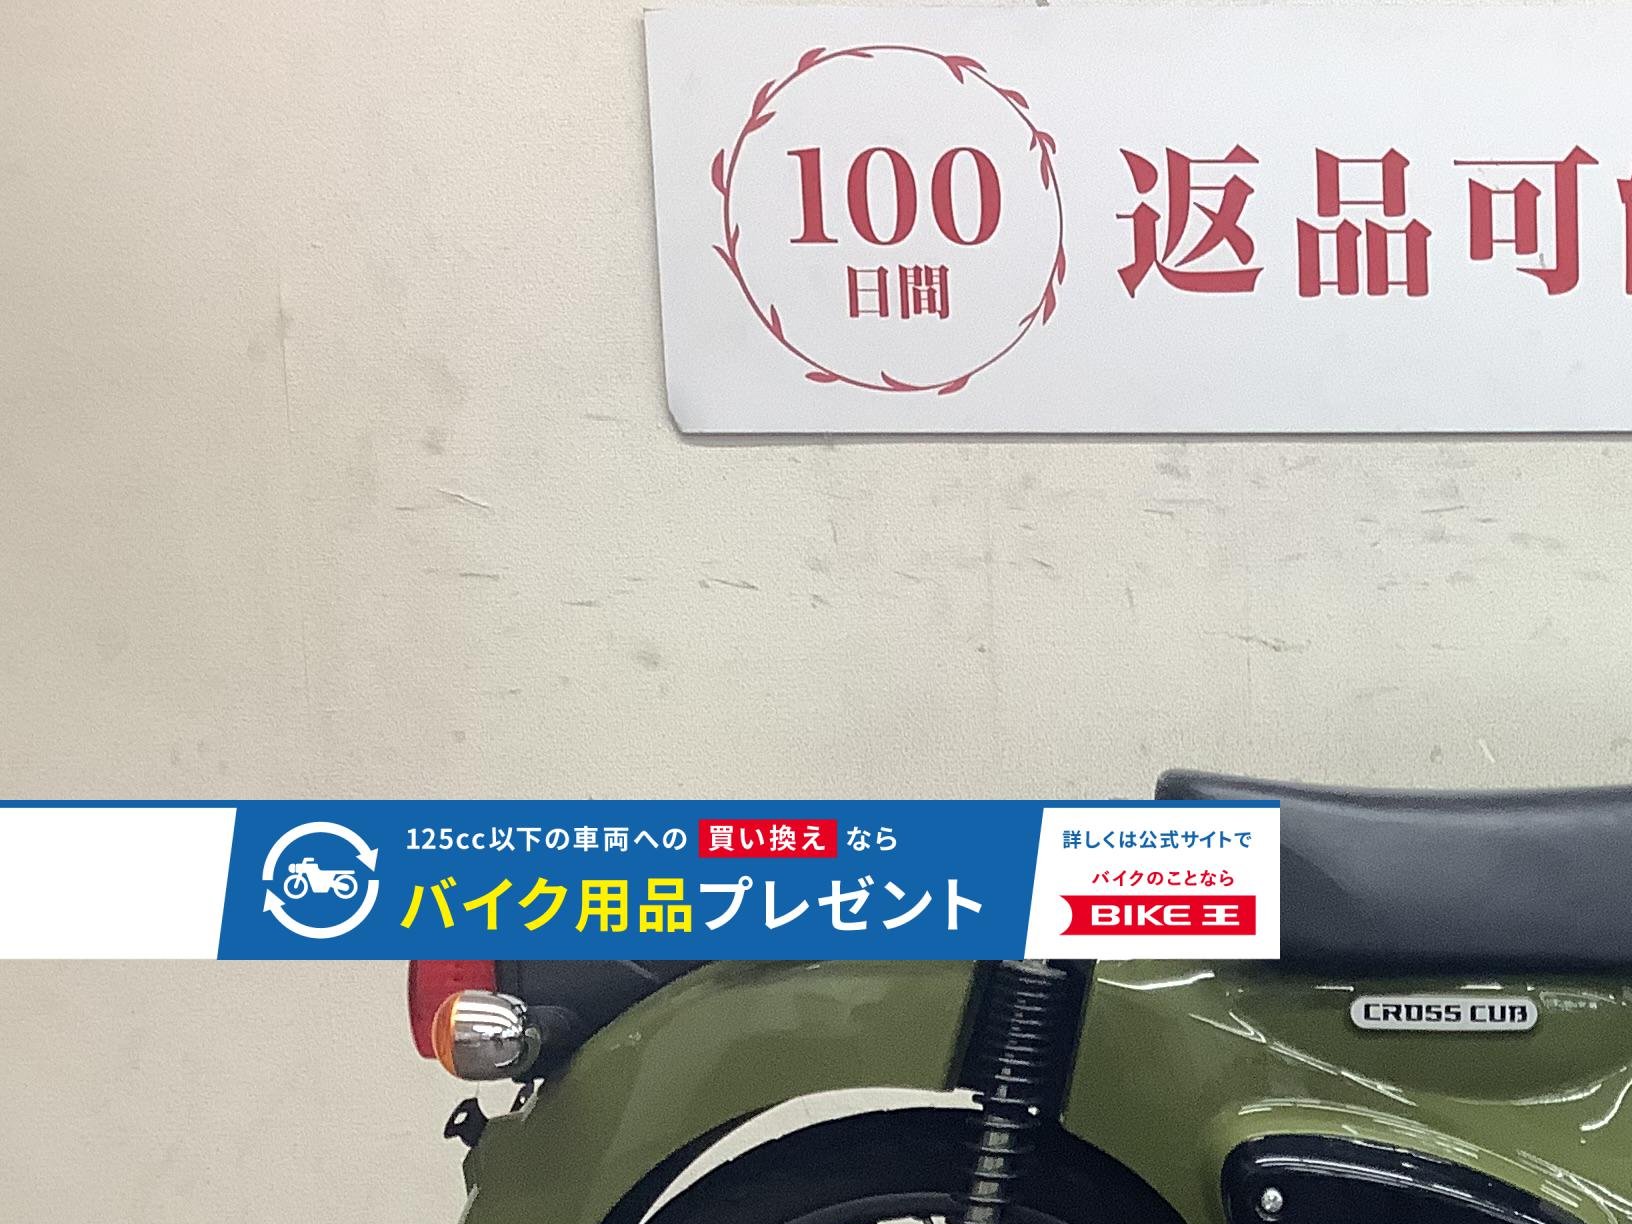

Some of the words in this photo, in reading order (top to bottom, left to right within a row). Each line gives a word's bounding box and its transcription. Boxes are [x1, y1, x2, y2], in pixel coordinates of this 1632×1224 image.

[788, 147, 1002, 246] 100
[845, 264, 950, 321] 日間
[1364, 1004, 1461, 1022] CROSS
[1471, 1005, 1527, 1023] CUB
